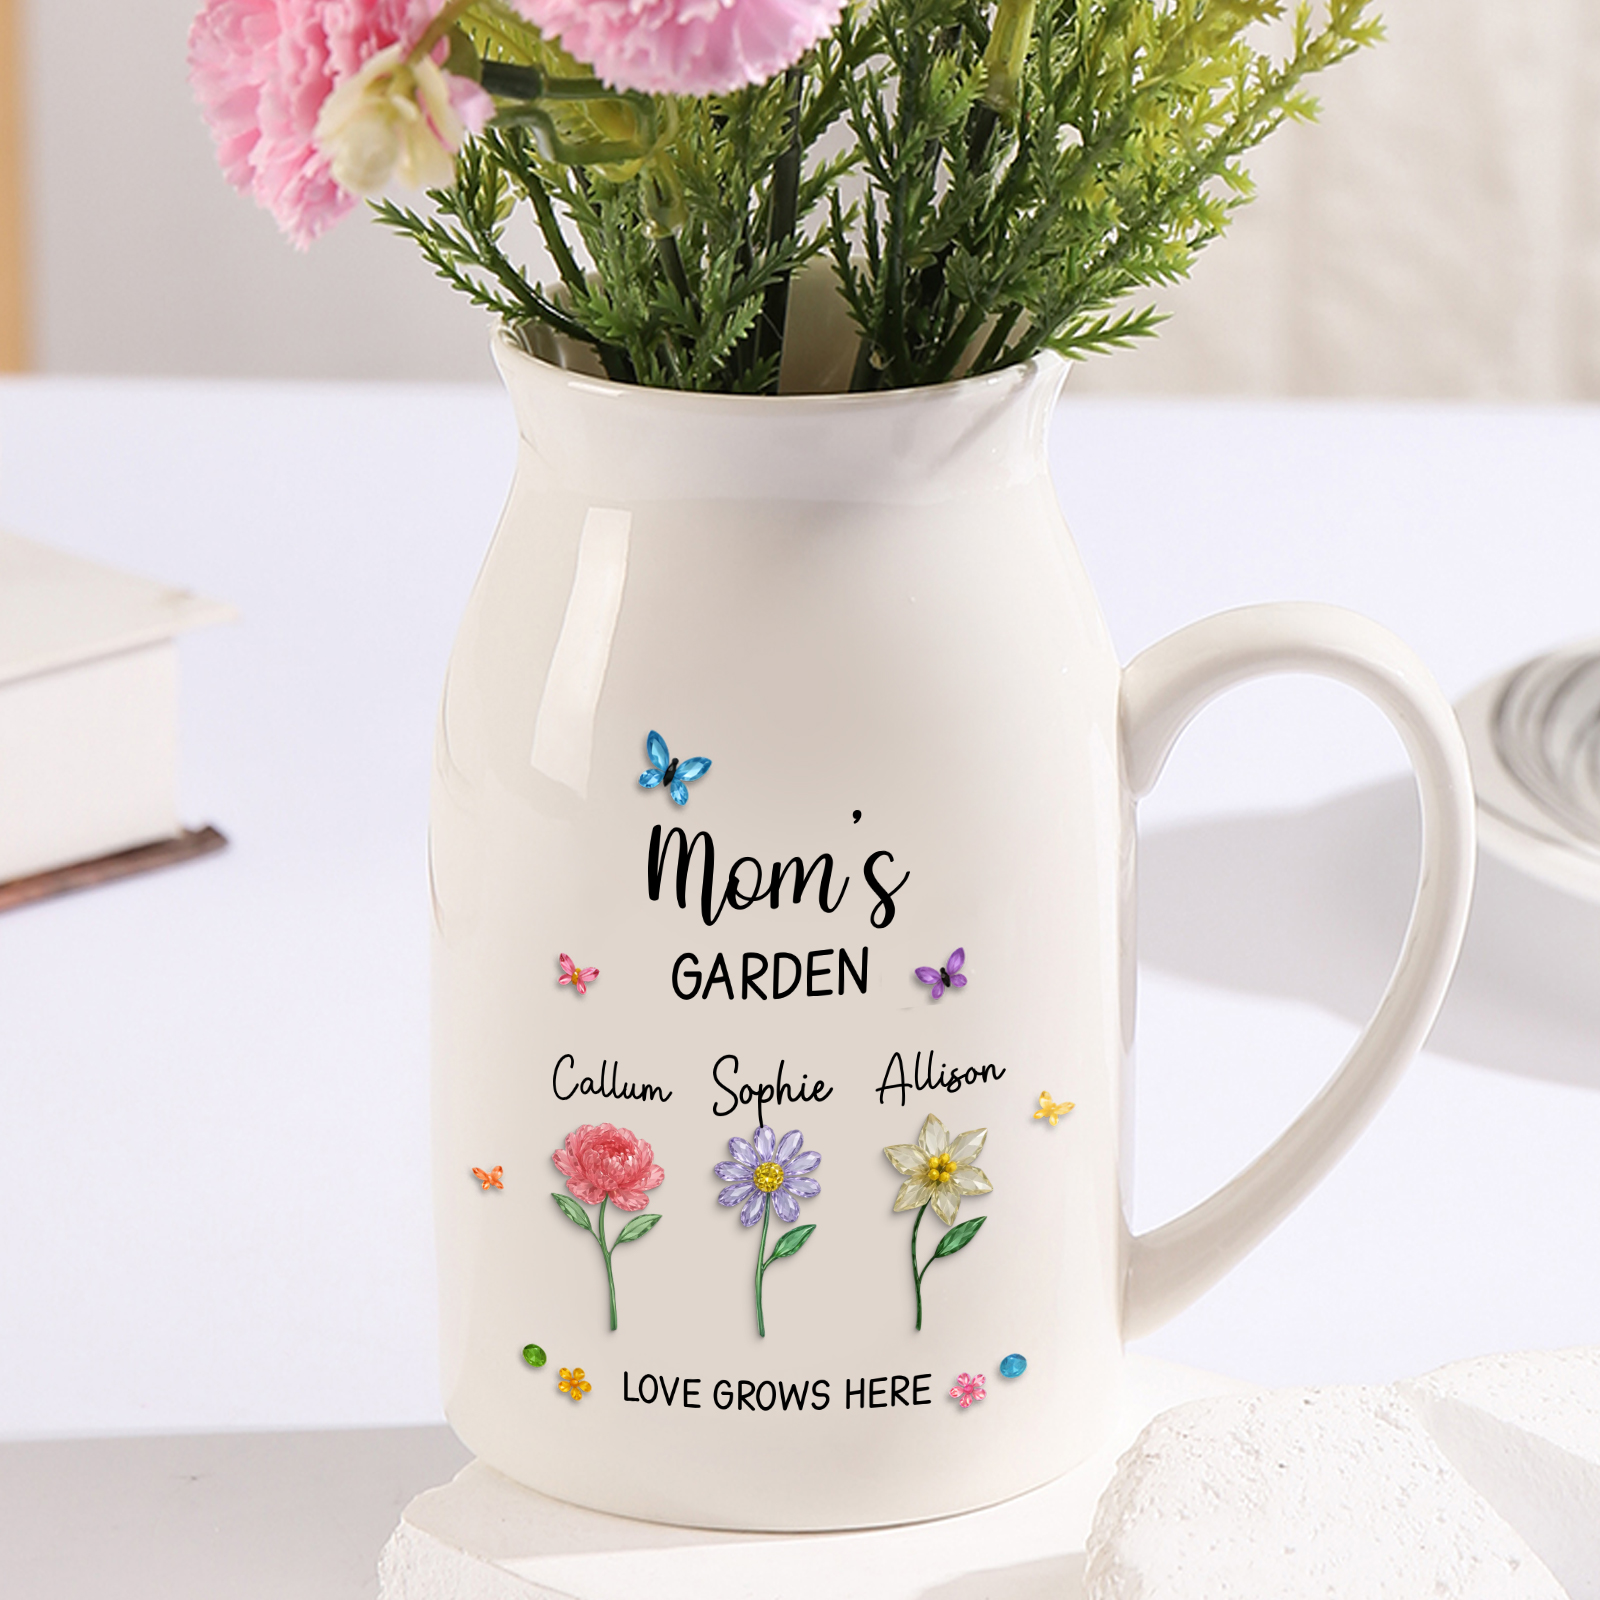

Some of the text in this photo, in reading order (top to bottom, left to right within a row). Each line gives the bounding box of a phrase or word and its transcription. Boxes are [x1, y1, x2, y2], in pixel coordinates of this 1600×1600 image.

[648, 809, 911, 929] Mom's
[671, 946, 869, 1001] GARDEN
[552, 1053, 673, 1103] Callum
[712, 1054, 834, 1128] Sophie
[875, 1049, 1007, 1107] Allison
[623, 1371, 932, 1412] LOVE GROWS HERE
